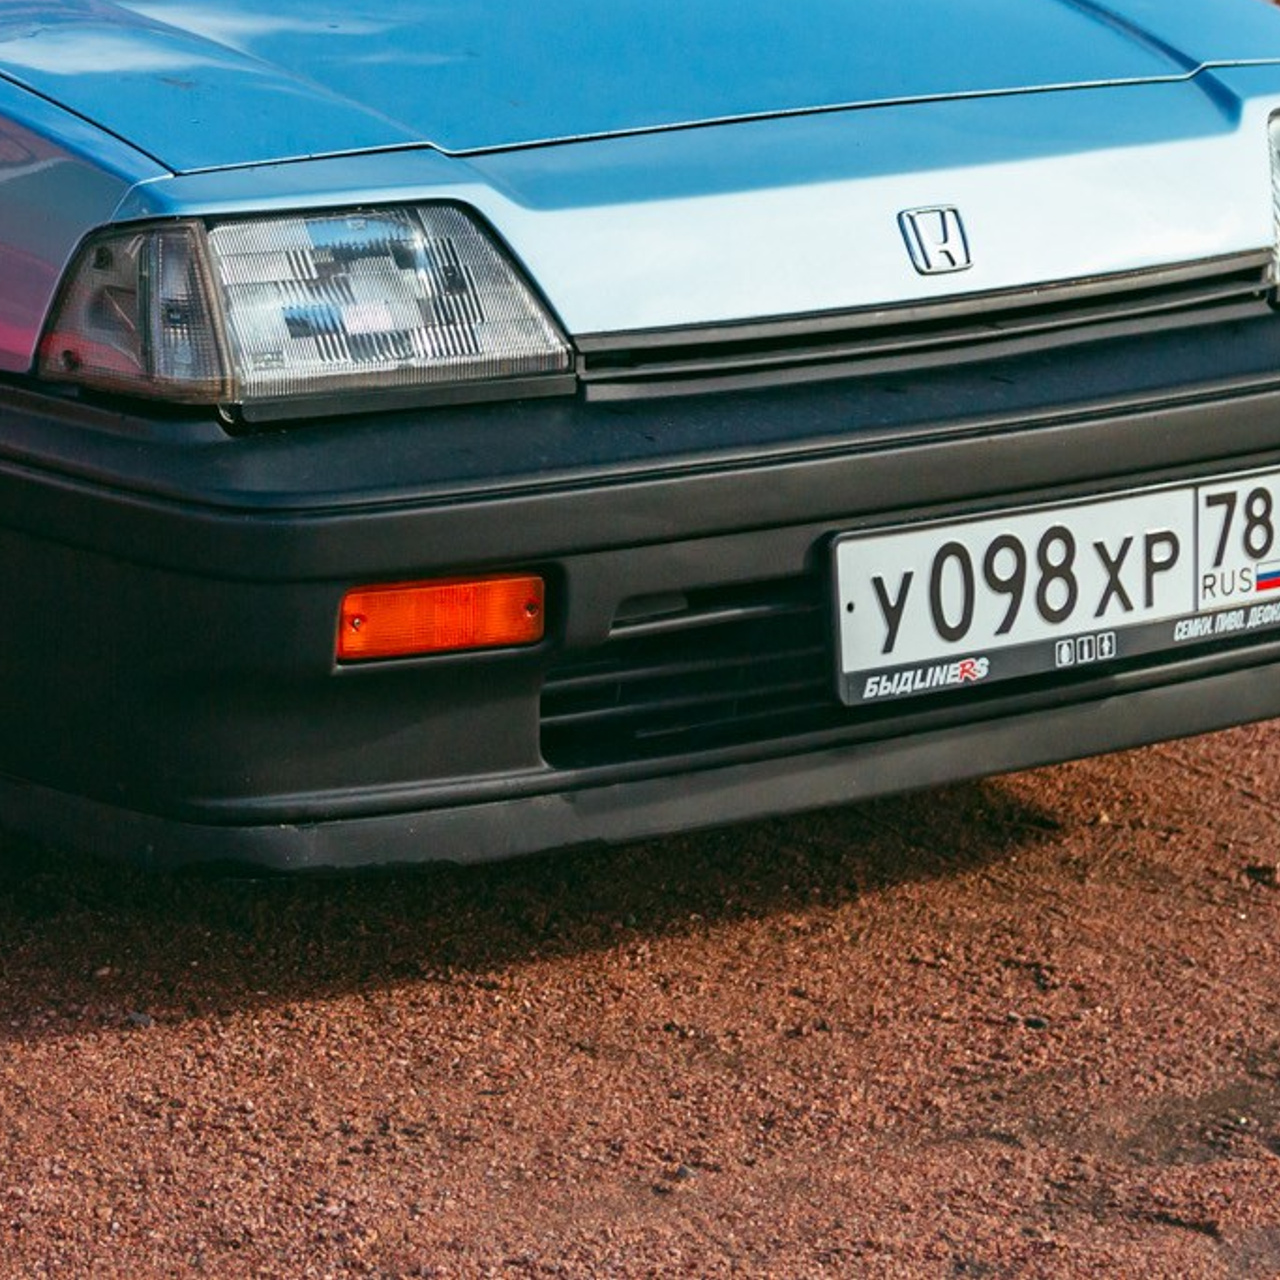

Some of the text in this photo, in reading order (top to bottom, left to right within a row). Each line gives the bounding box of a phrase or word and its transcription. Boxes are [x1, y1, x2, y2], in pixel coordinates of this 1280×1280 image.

[872, 487, 1274, 654] У098ХР 78
[1202, 567, 1253, 600] RUS
